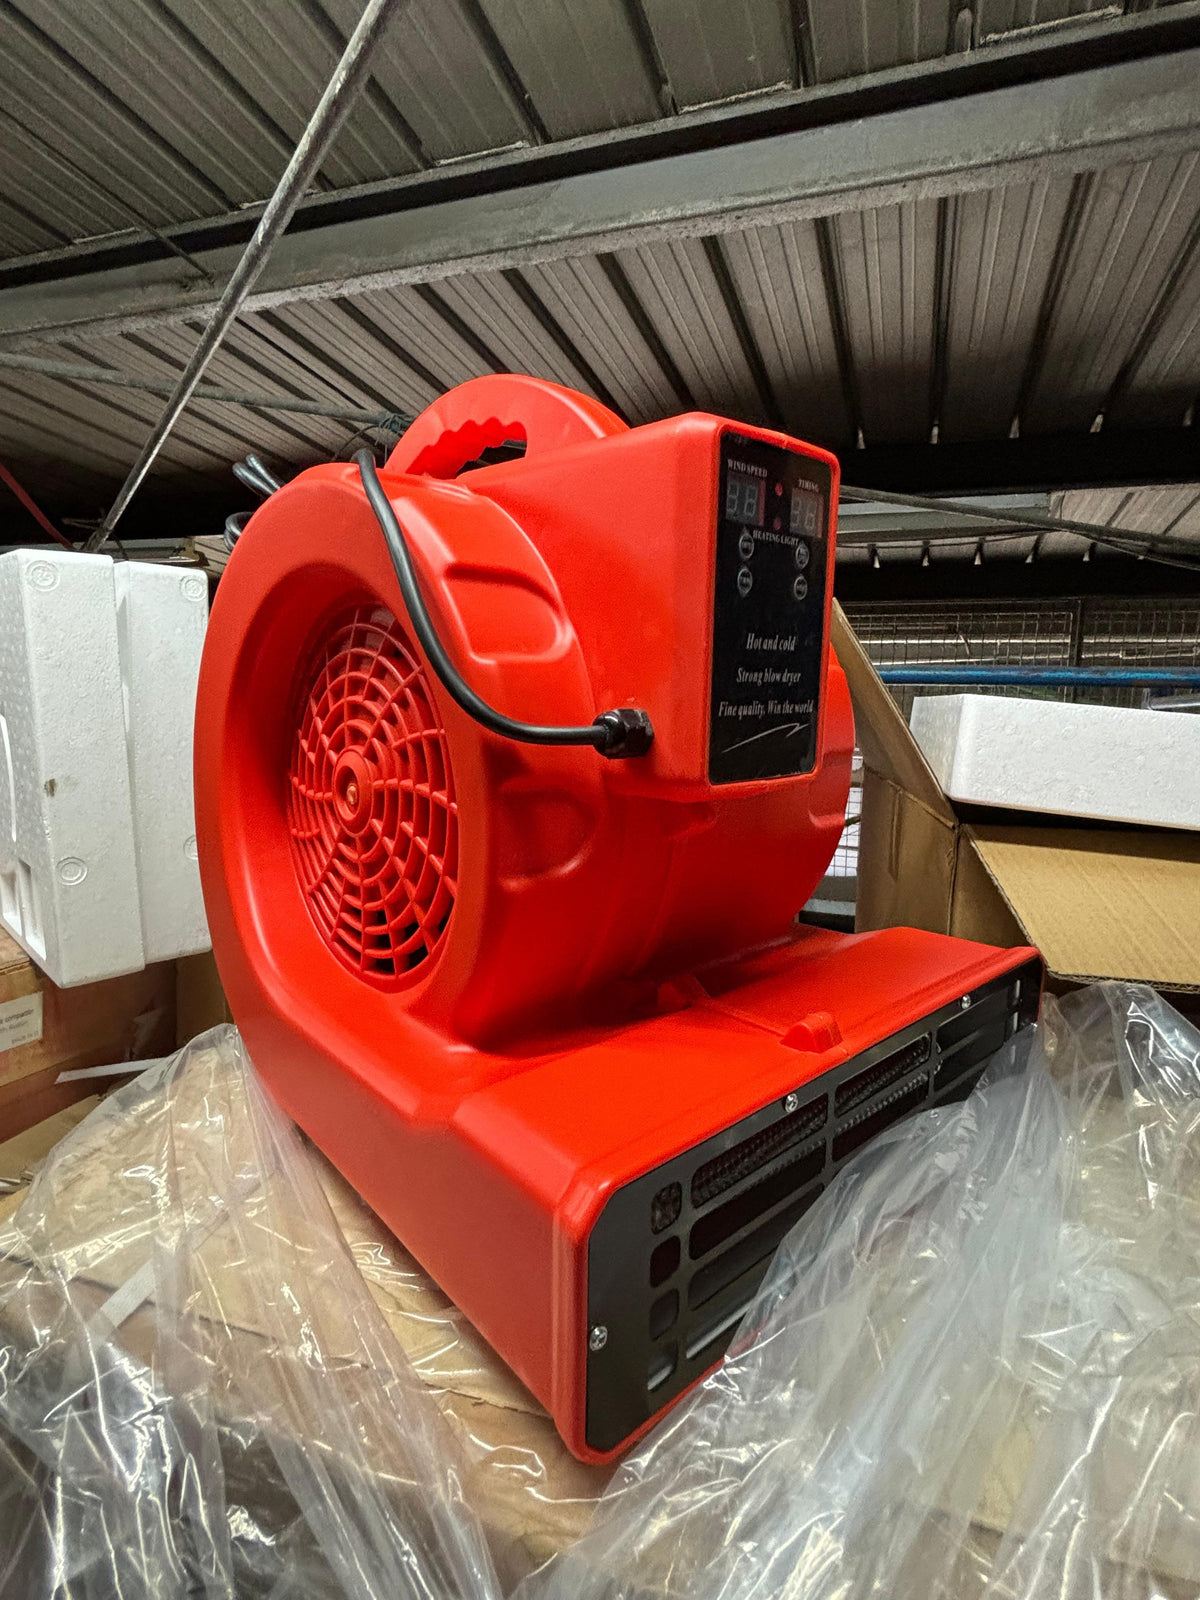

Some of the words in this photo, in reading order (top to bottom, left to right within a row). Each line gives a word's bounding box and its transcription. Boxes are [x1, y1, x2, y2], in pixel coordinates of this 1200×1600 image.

[747, 465, 768, 477] SPEED
[798, 479, 819, 493] TIMING
[753, 529, 780, 543] HEATING
[781, 535, 799, 546] LIGHT
[746, 633, 762, 650] Hot
[762, 635, 779, 651] and
[779, 635, 796, 651] cold
[736, 667, 763, 687] Strong
[764, 668, 782, 683] blow
[782, 668, 801, 687] dryer
[719, 701, 737, 716] Fine
[768, 700, 781, 714] Win
[782, 701, 794, 714] the
[795, 699, 814, 713] world
